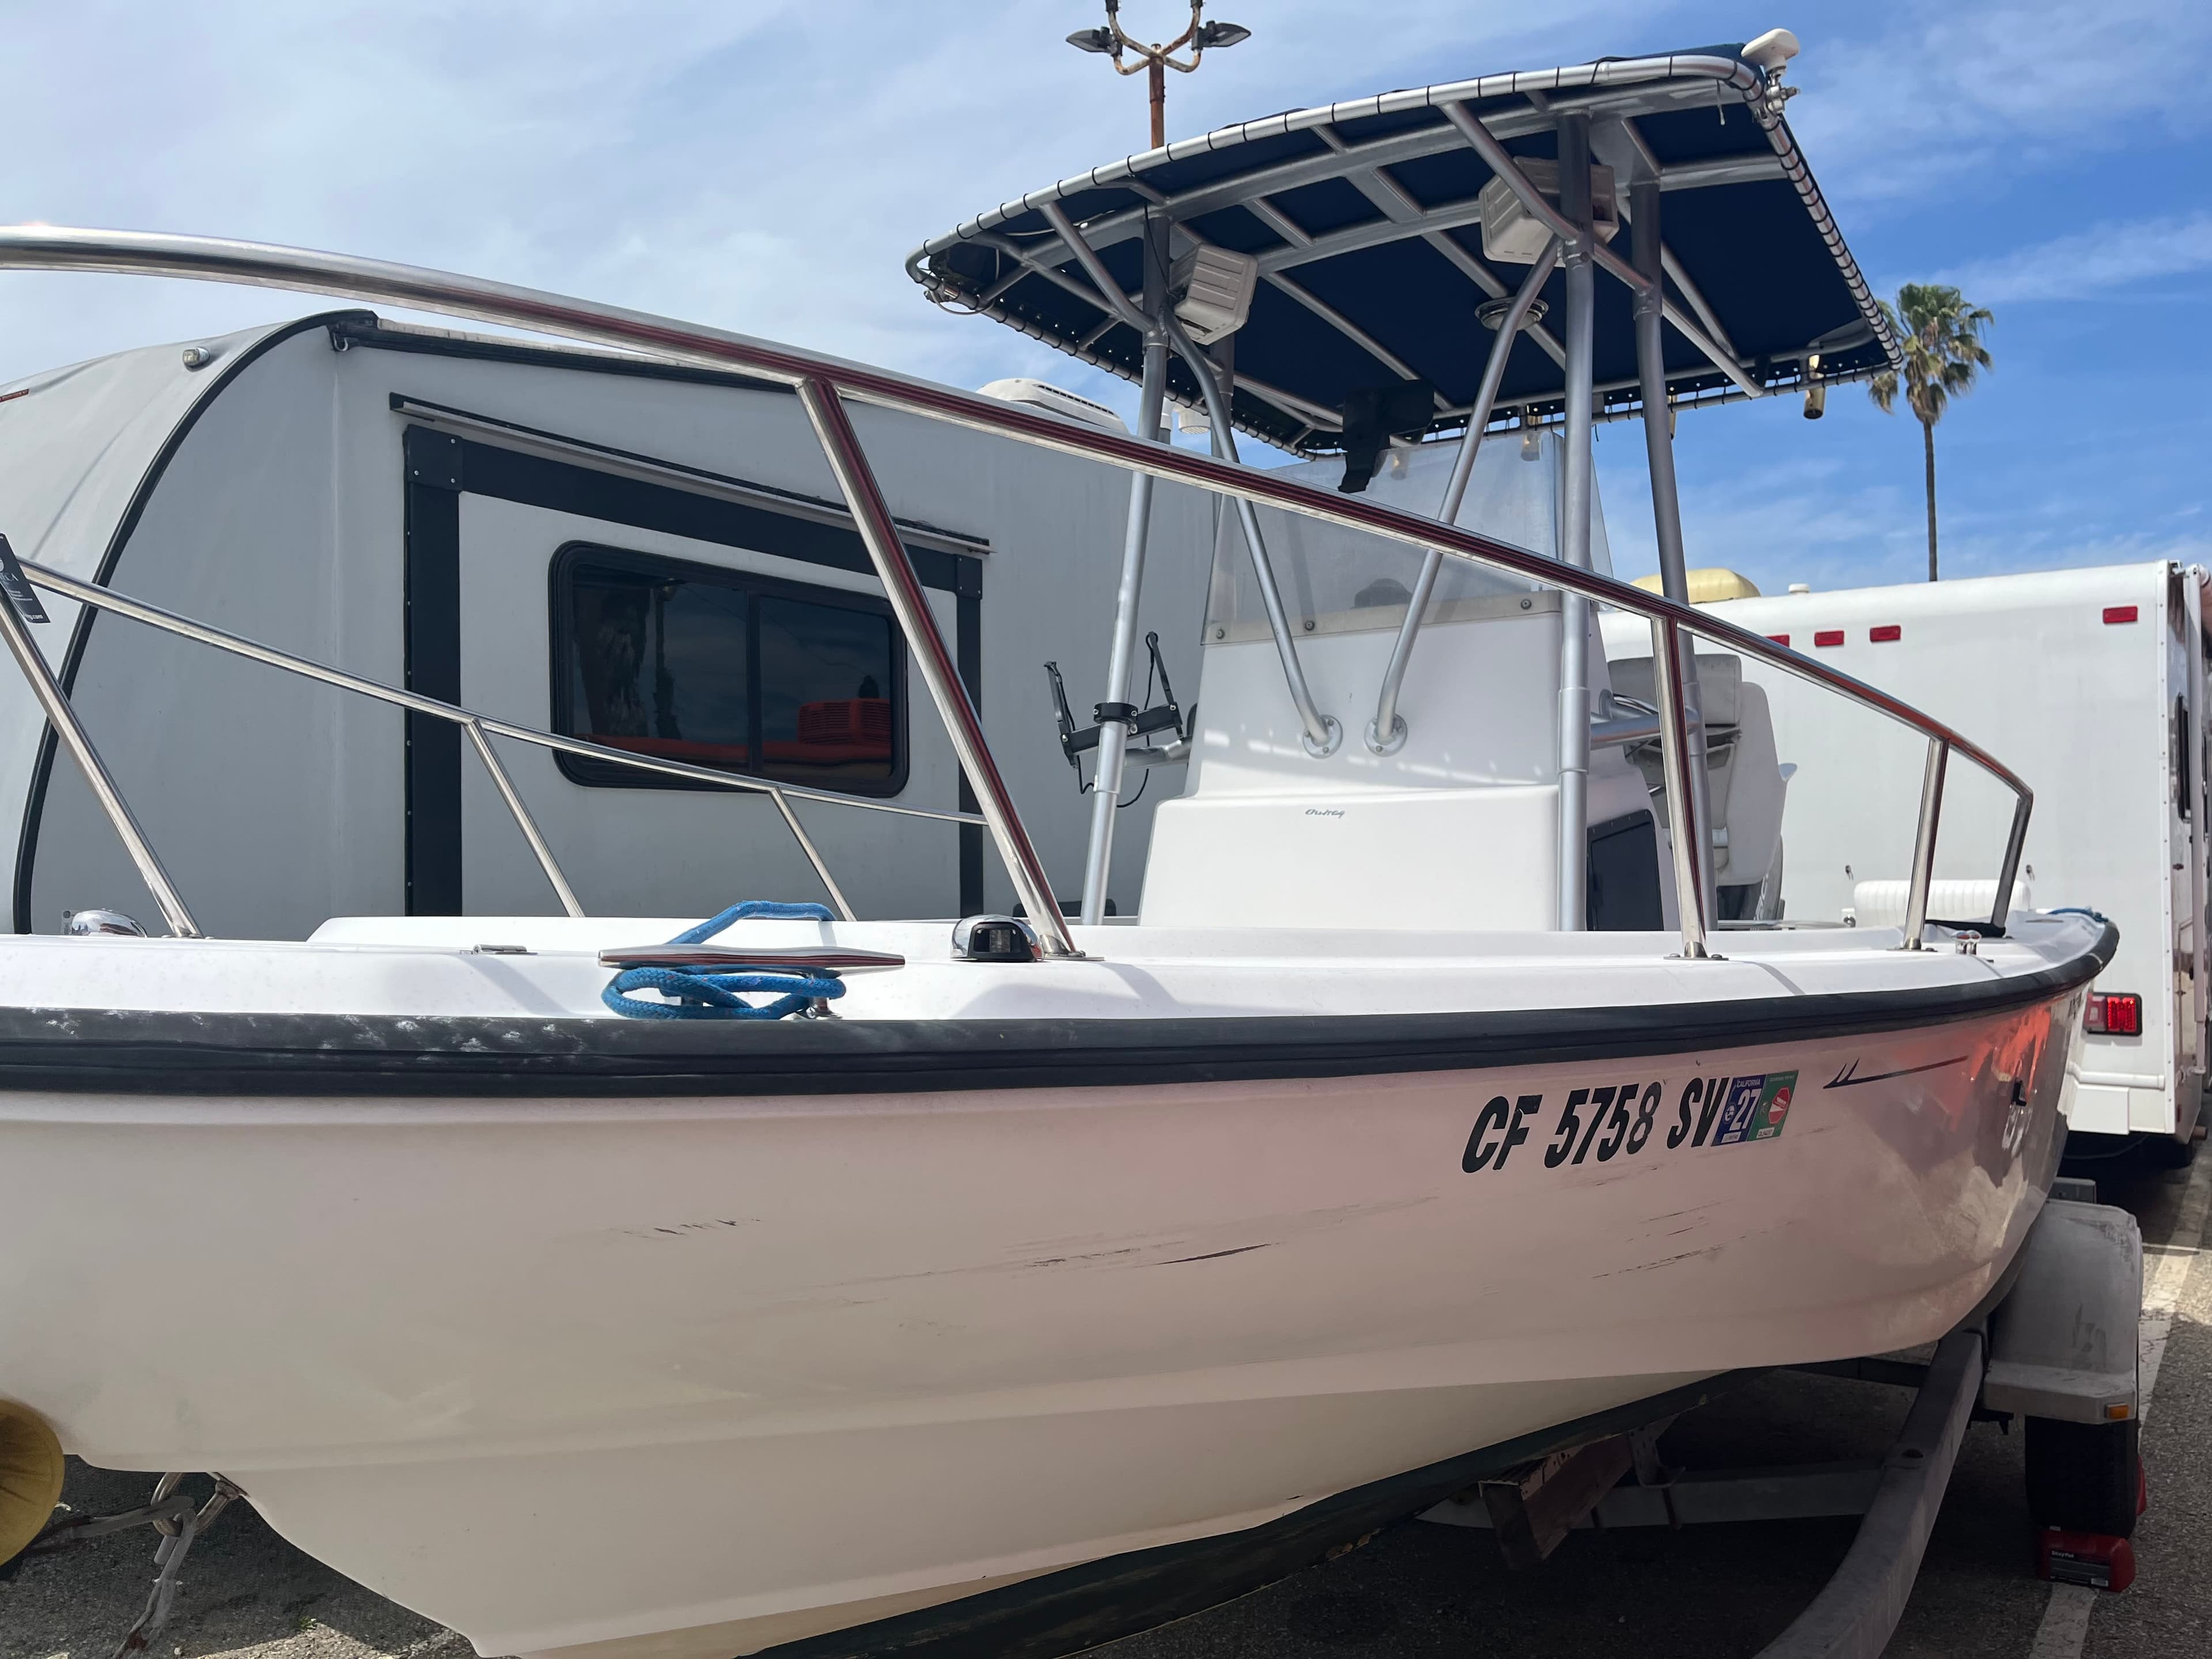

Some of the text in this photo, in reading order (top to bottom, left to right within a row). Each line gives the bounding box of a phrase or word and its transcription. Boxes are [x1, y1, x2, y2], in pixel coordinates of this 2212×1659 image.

[1736, 1078, 1761, 1088] CALIFORNIA
[1461, 1077, 1730, 1173] CF 5758 SV
[1729, 1088, 1763, 1131] 27
